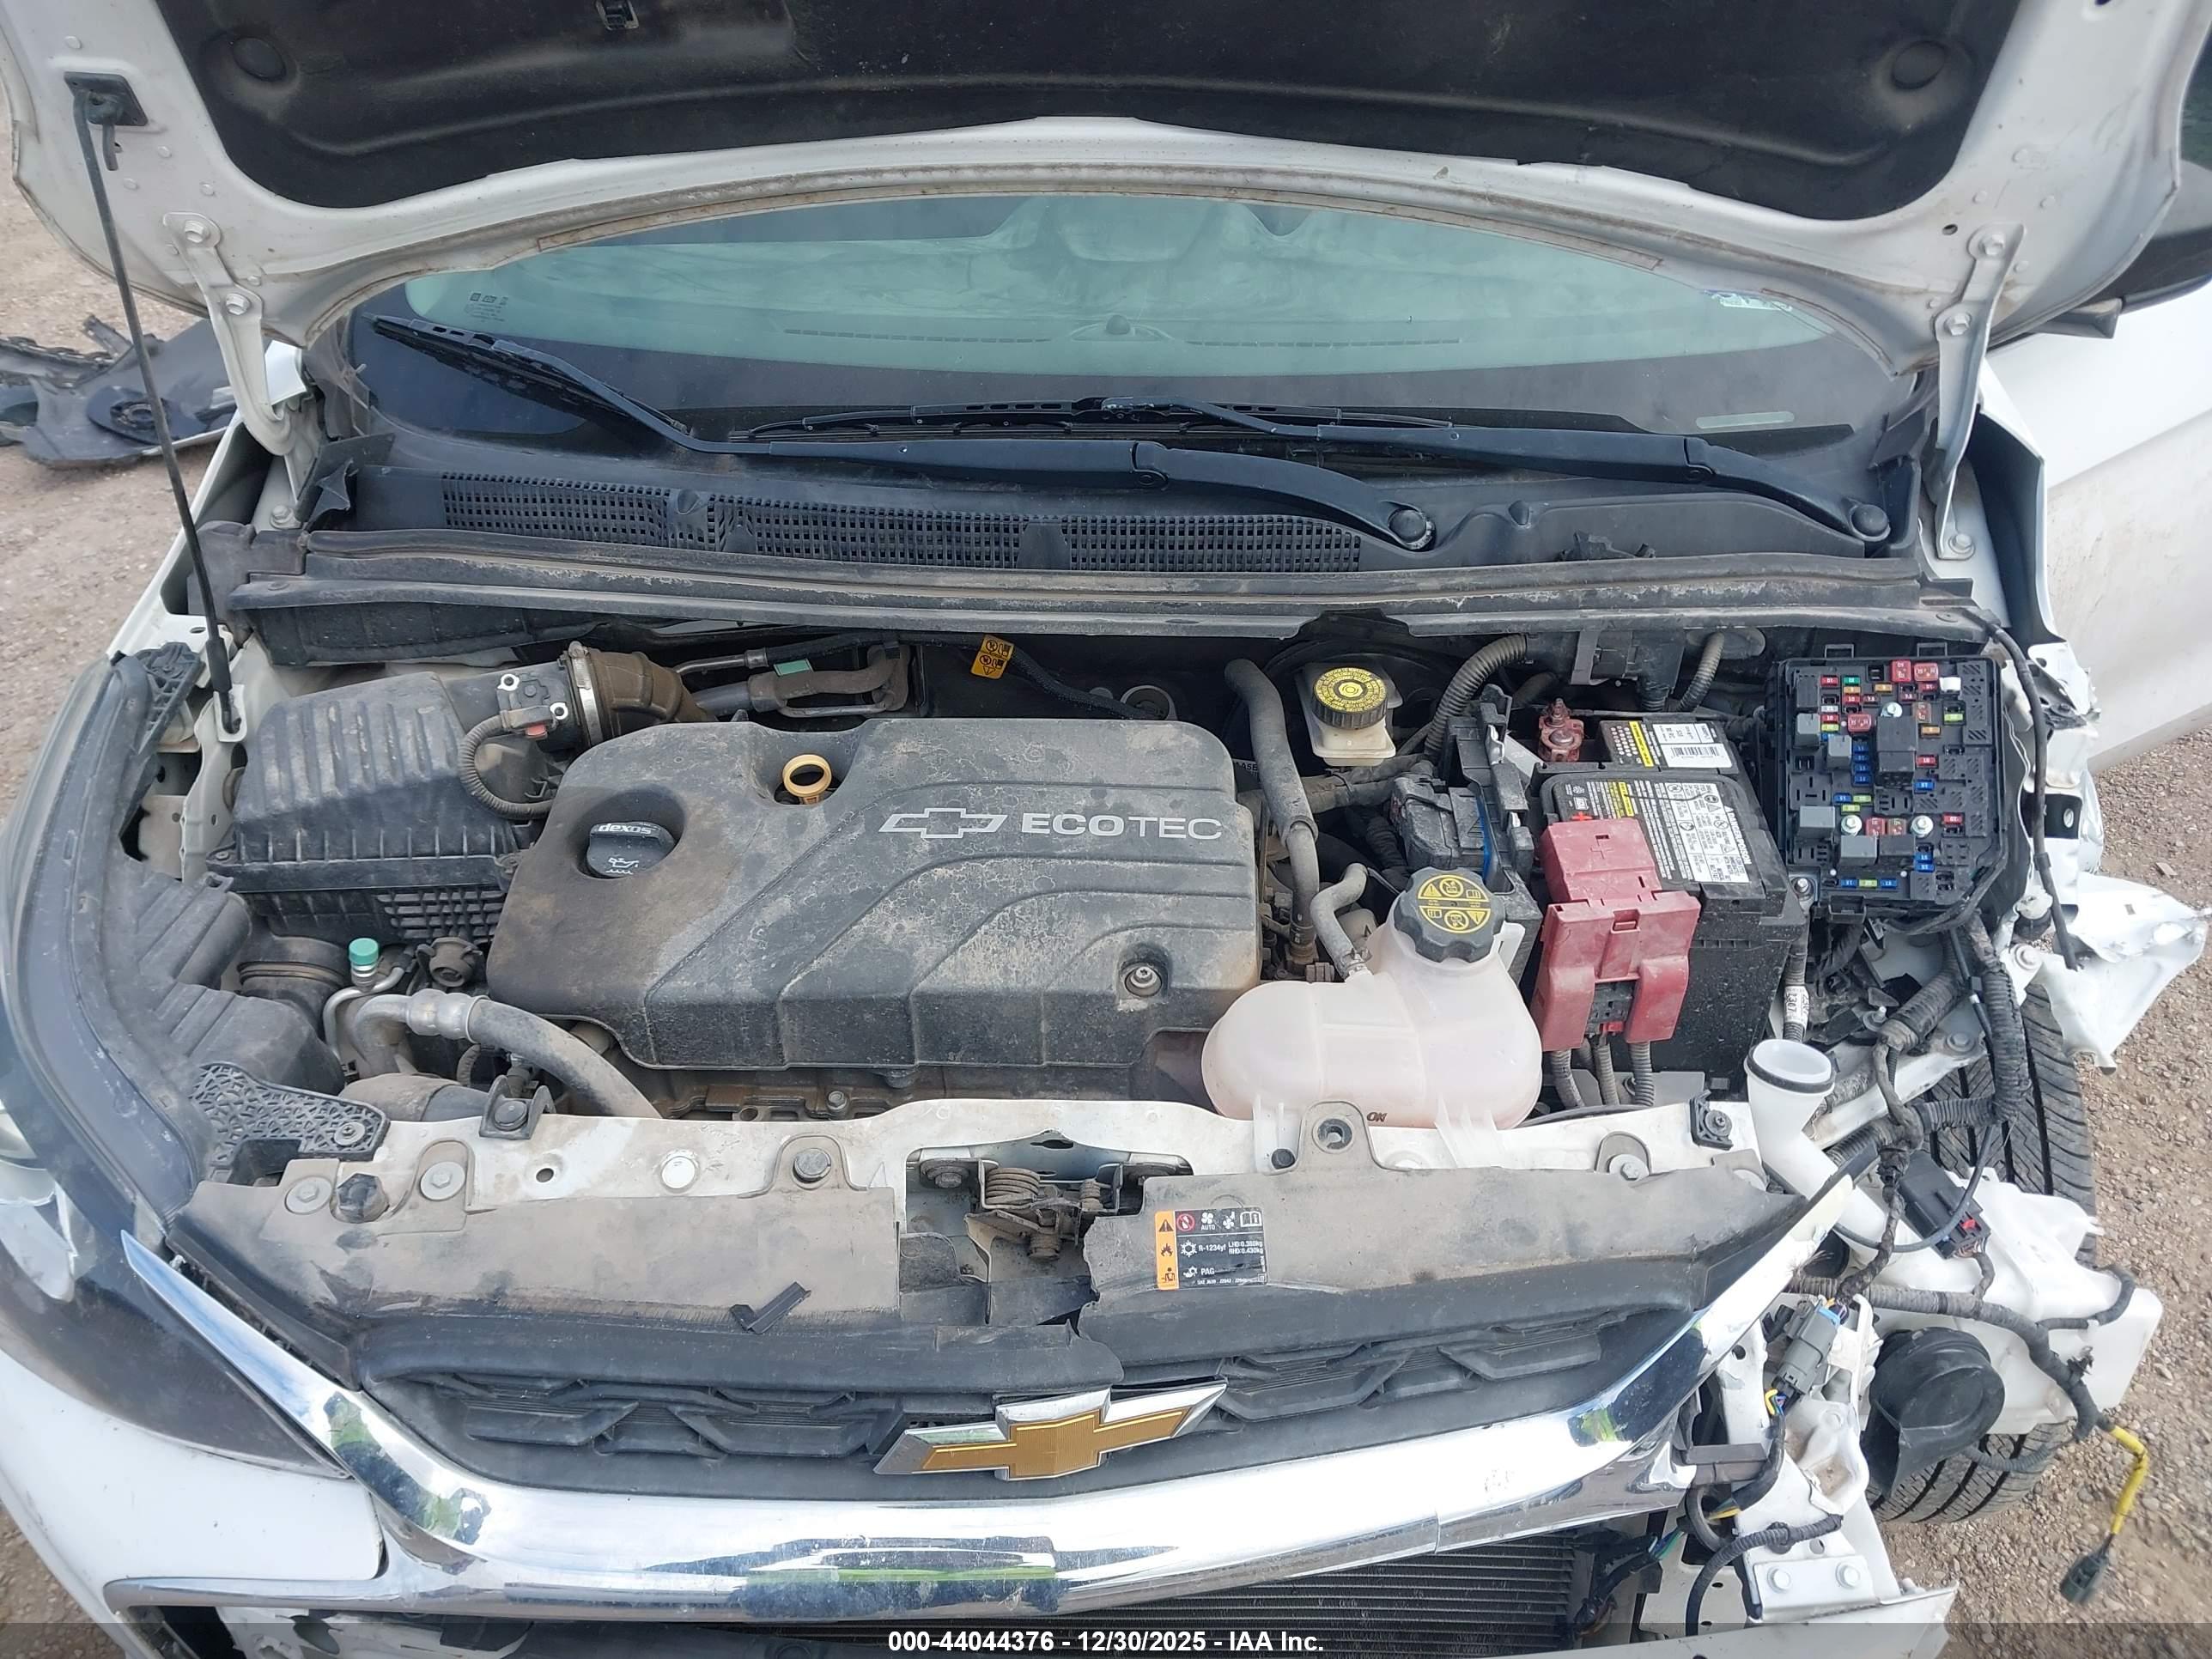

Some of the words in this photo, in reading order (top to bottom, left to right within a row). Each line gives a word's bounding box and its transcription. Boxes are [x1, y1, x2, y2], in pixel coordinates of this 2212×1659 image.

[599, 823, 652, 835] dexos
[1022, 812, 1222, 840] ECOTEC
[1199, 1243, 1226, 1252] R-1234yf
